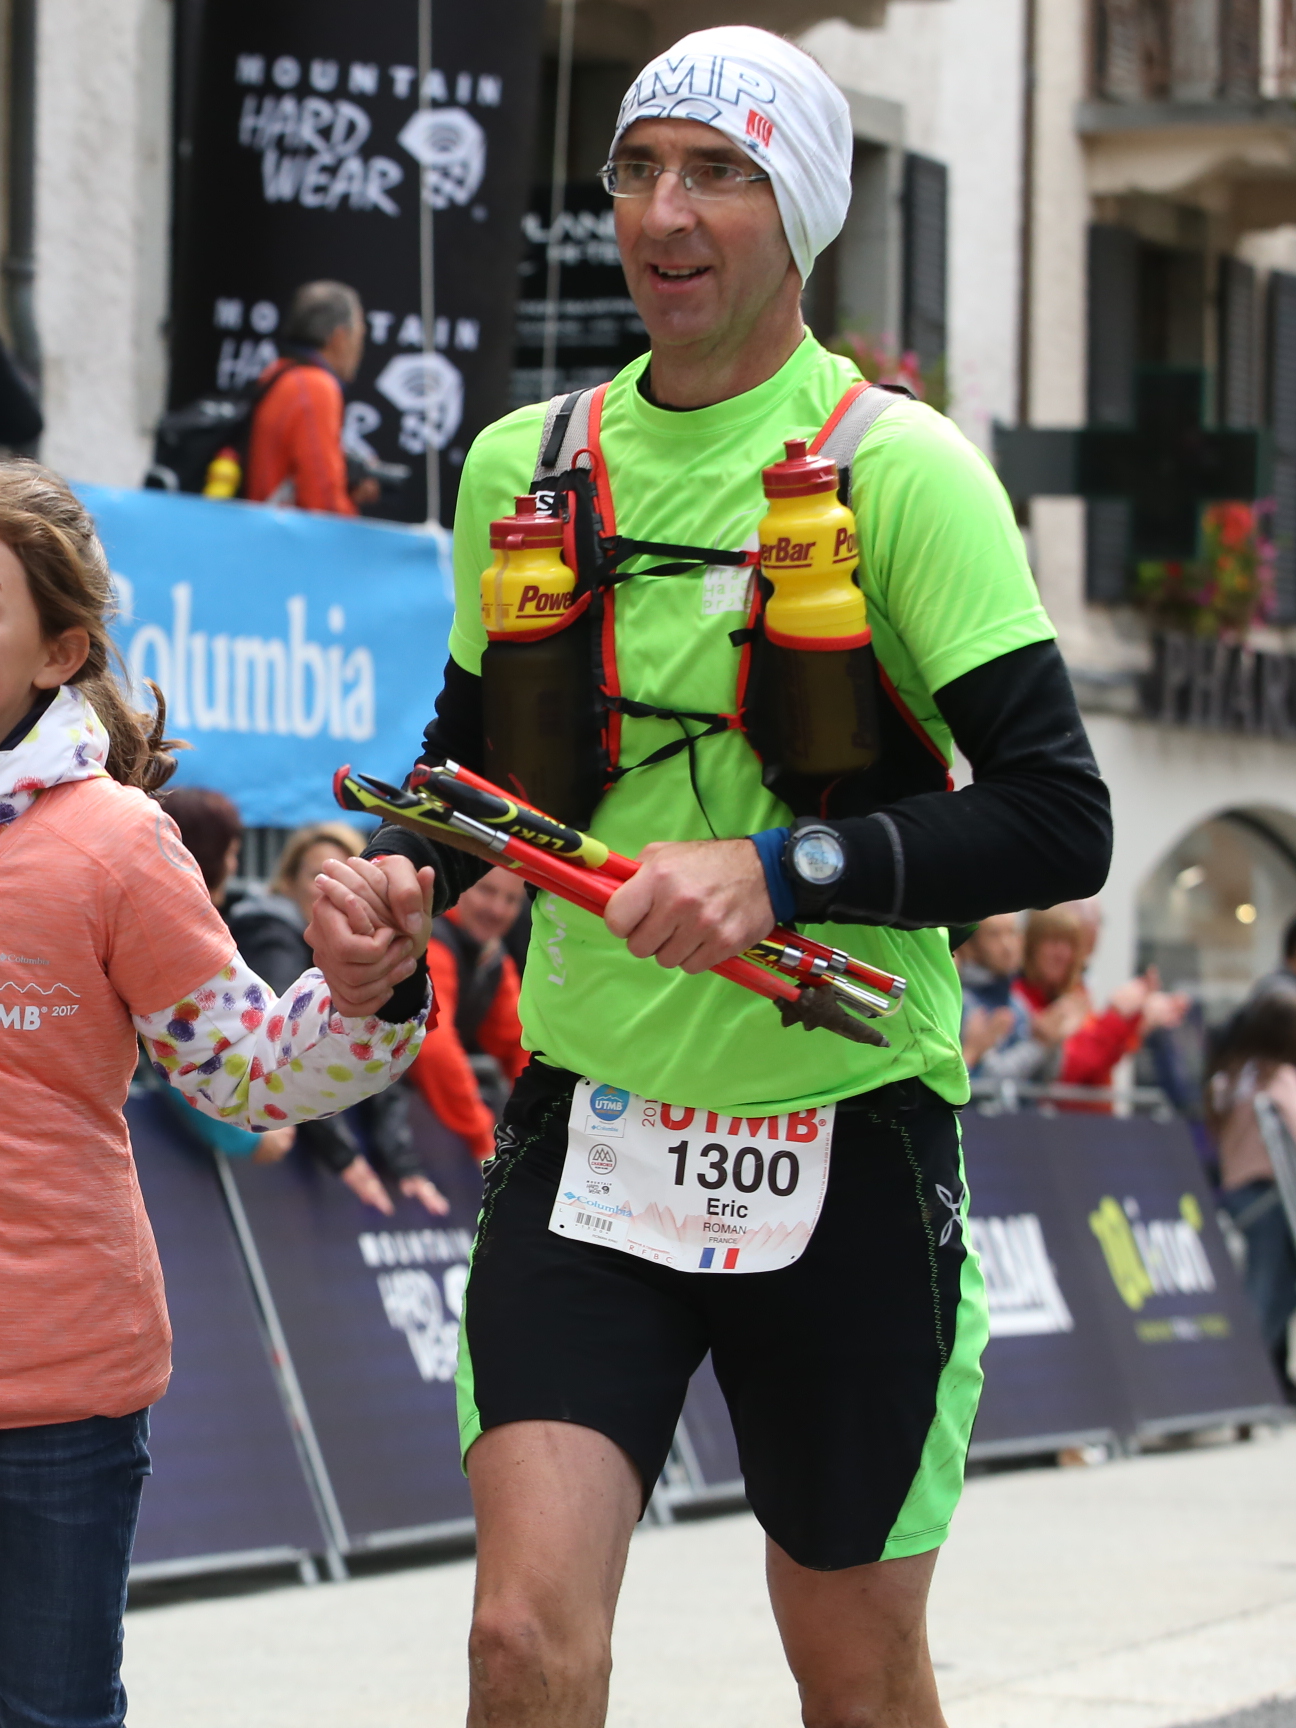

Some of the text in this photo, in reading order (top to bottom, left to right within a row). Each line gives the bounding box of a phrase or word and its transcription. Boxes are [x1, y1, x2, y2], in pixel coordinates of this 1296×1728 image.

[235, 54, 502, 107] MOUNTAIN
[238, 94, 371, 158] HARD
[263, 150, 404, 217] WEAR
[214, 297, 480, 351] MOTAIN
[509, 825, 565, 850] LEKI
[7, 953, 50, 967] Columbia
[51, 1004, 79, 1017] 2017
[595, 1100, 623, 1111] UTMB
[668, 1140, 800, 1197] 1300
[576, 1195, 634, 1218] Columbia
[706, 1197, 748, 1218] Eric
[703, 1222, 747, 1235] ROMAN
[708, 1236, 738, 1245] FRANCE
